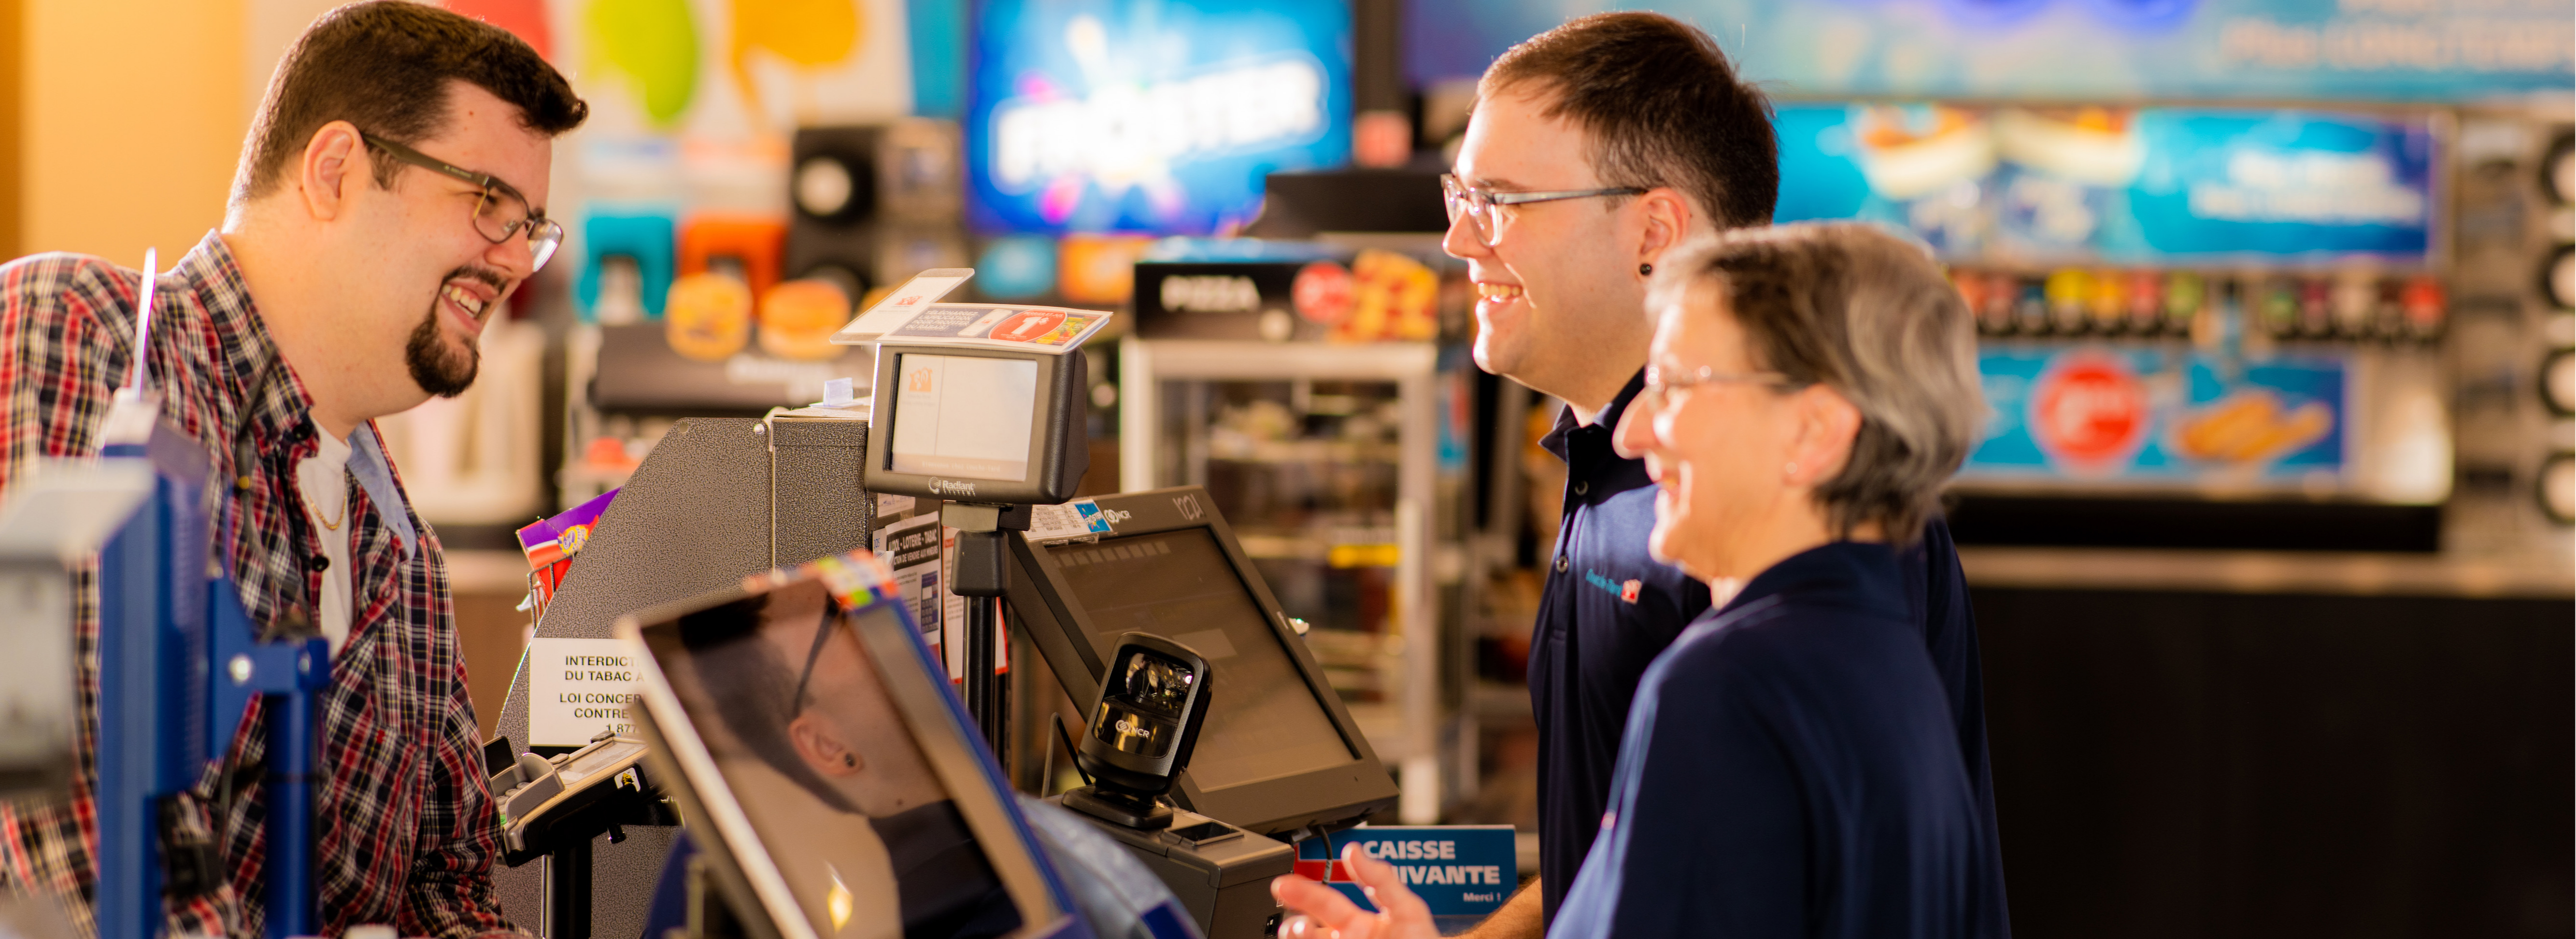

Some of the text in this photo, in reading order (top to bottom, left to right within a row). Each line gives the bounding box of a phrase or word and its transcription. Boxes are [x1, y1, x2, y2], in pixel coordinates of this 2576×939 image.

[1160, 274, 1262, 312] PIZZA
[942, 480, 974, 490] Radiant
[1116, 510, 1132, 520] NCR
[902, 533, 922, 549] LOTERIE
[924, 528, 937, 544] TABAC
[565, 670, 584, 681] DU
[588, 671, 632, 682] TABAC
[560, 693, 642, 704] LOI CONCER
[574, 708, 629, 719] CONTRE
[1131, 726, 1150, 739] NCR
[1363, 840, 1456, 860] CAISSE
[1392, 865, 1501, 885] IVANTE
[1463, 892, 1494, 902] Merci
